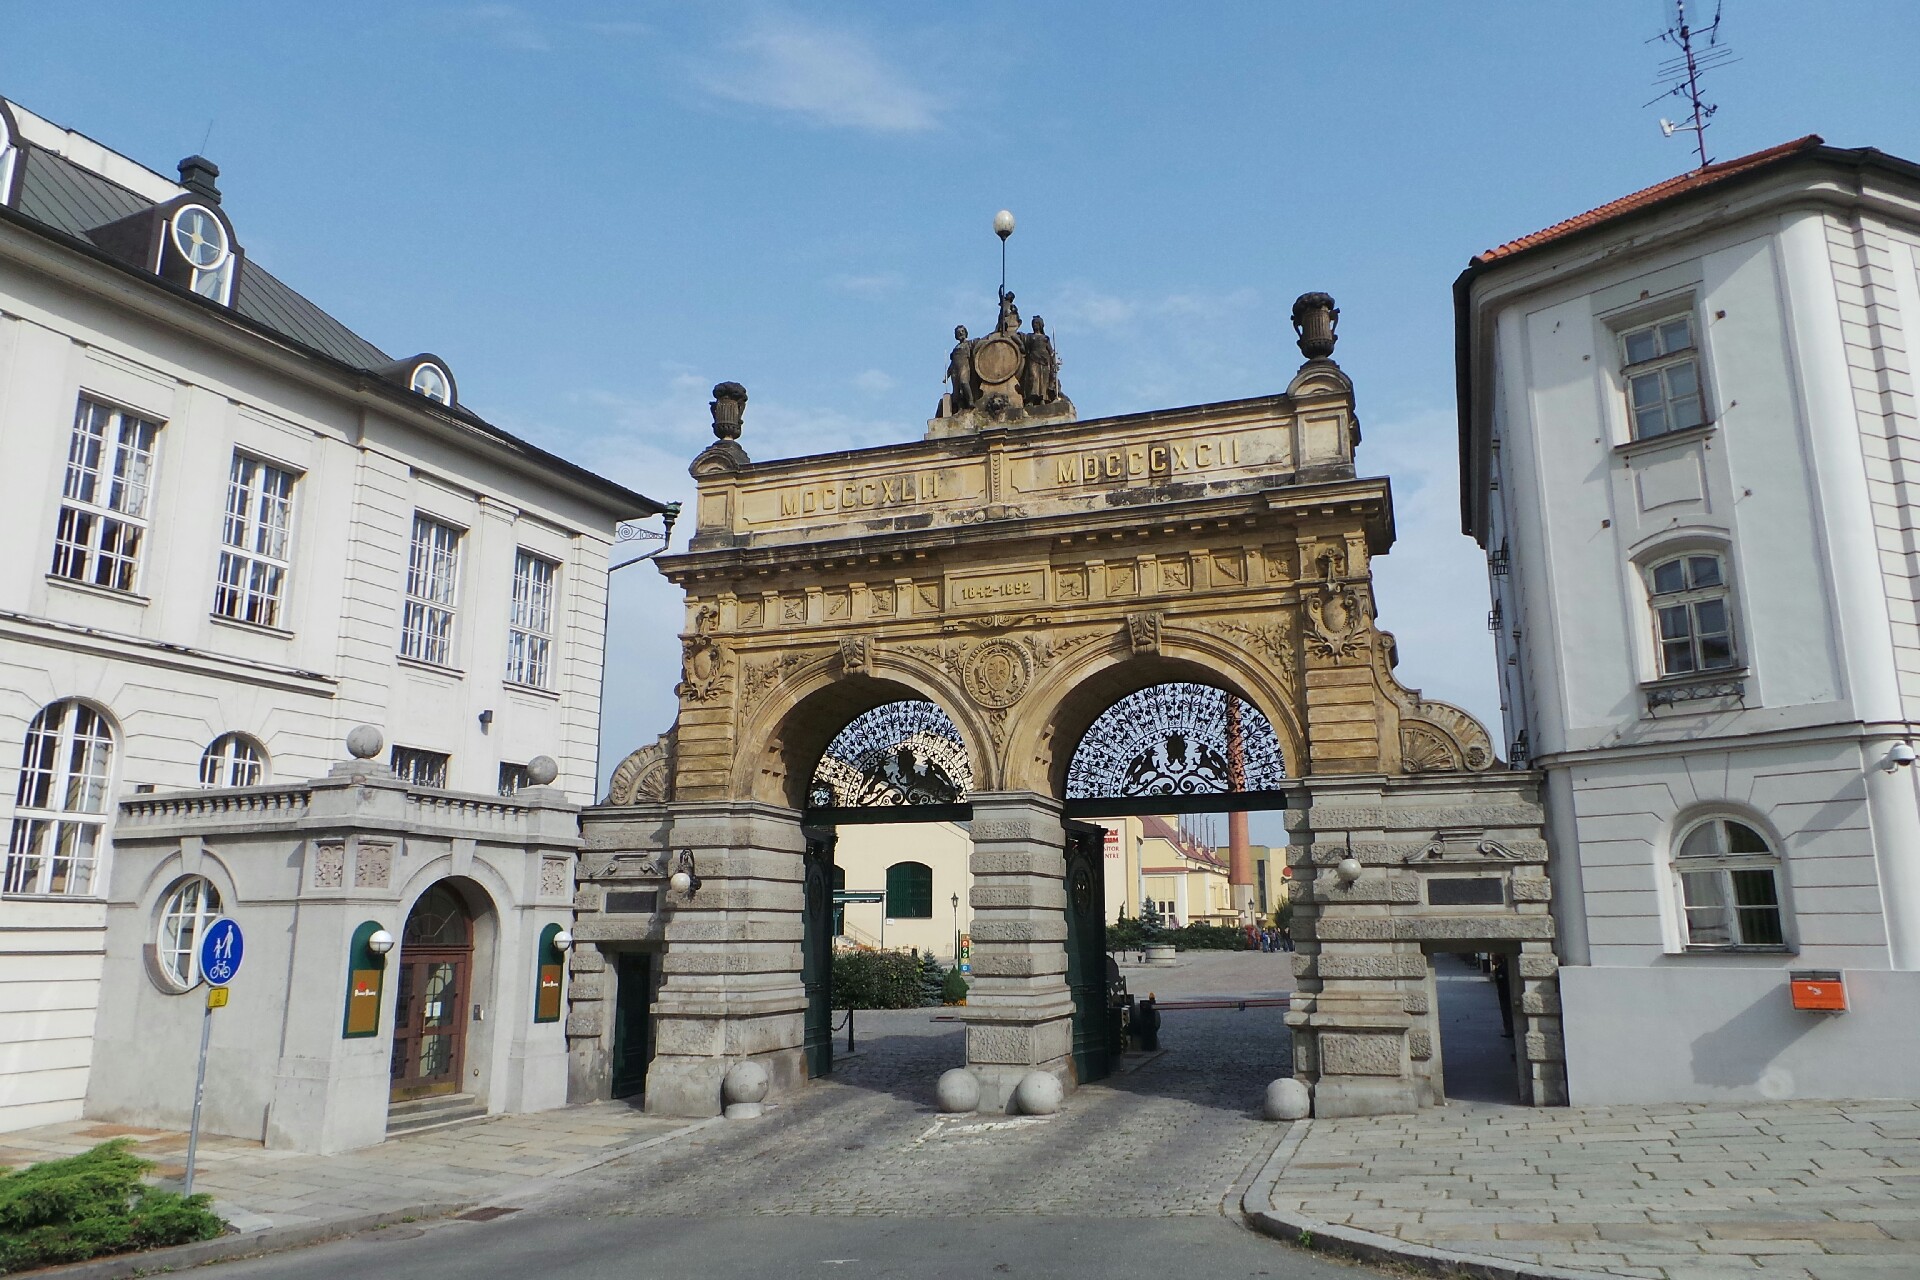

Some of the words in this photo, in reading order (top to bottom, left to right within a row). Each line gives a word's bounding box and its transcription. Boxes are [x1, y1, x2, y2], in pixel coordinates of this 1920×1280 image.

[1057, 439, 1240, 484] MDCCCXCII
[780, 473, 939, 516] MDCCCXLII
[962, 581, 1032, 600] 1842-1892
